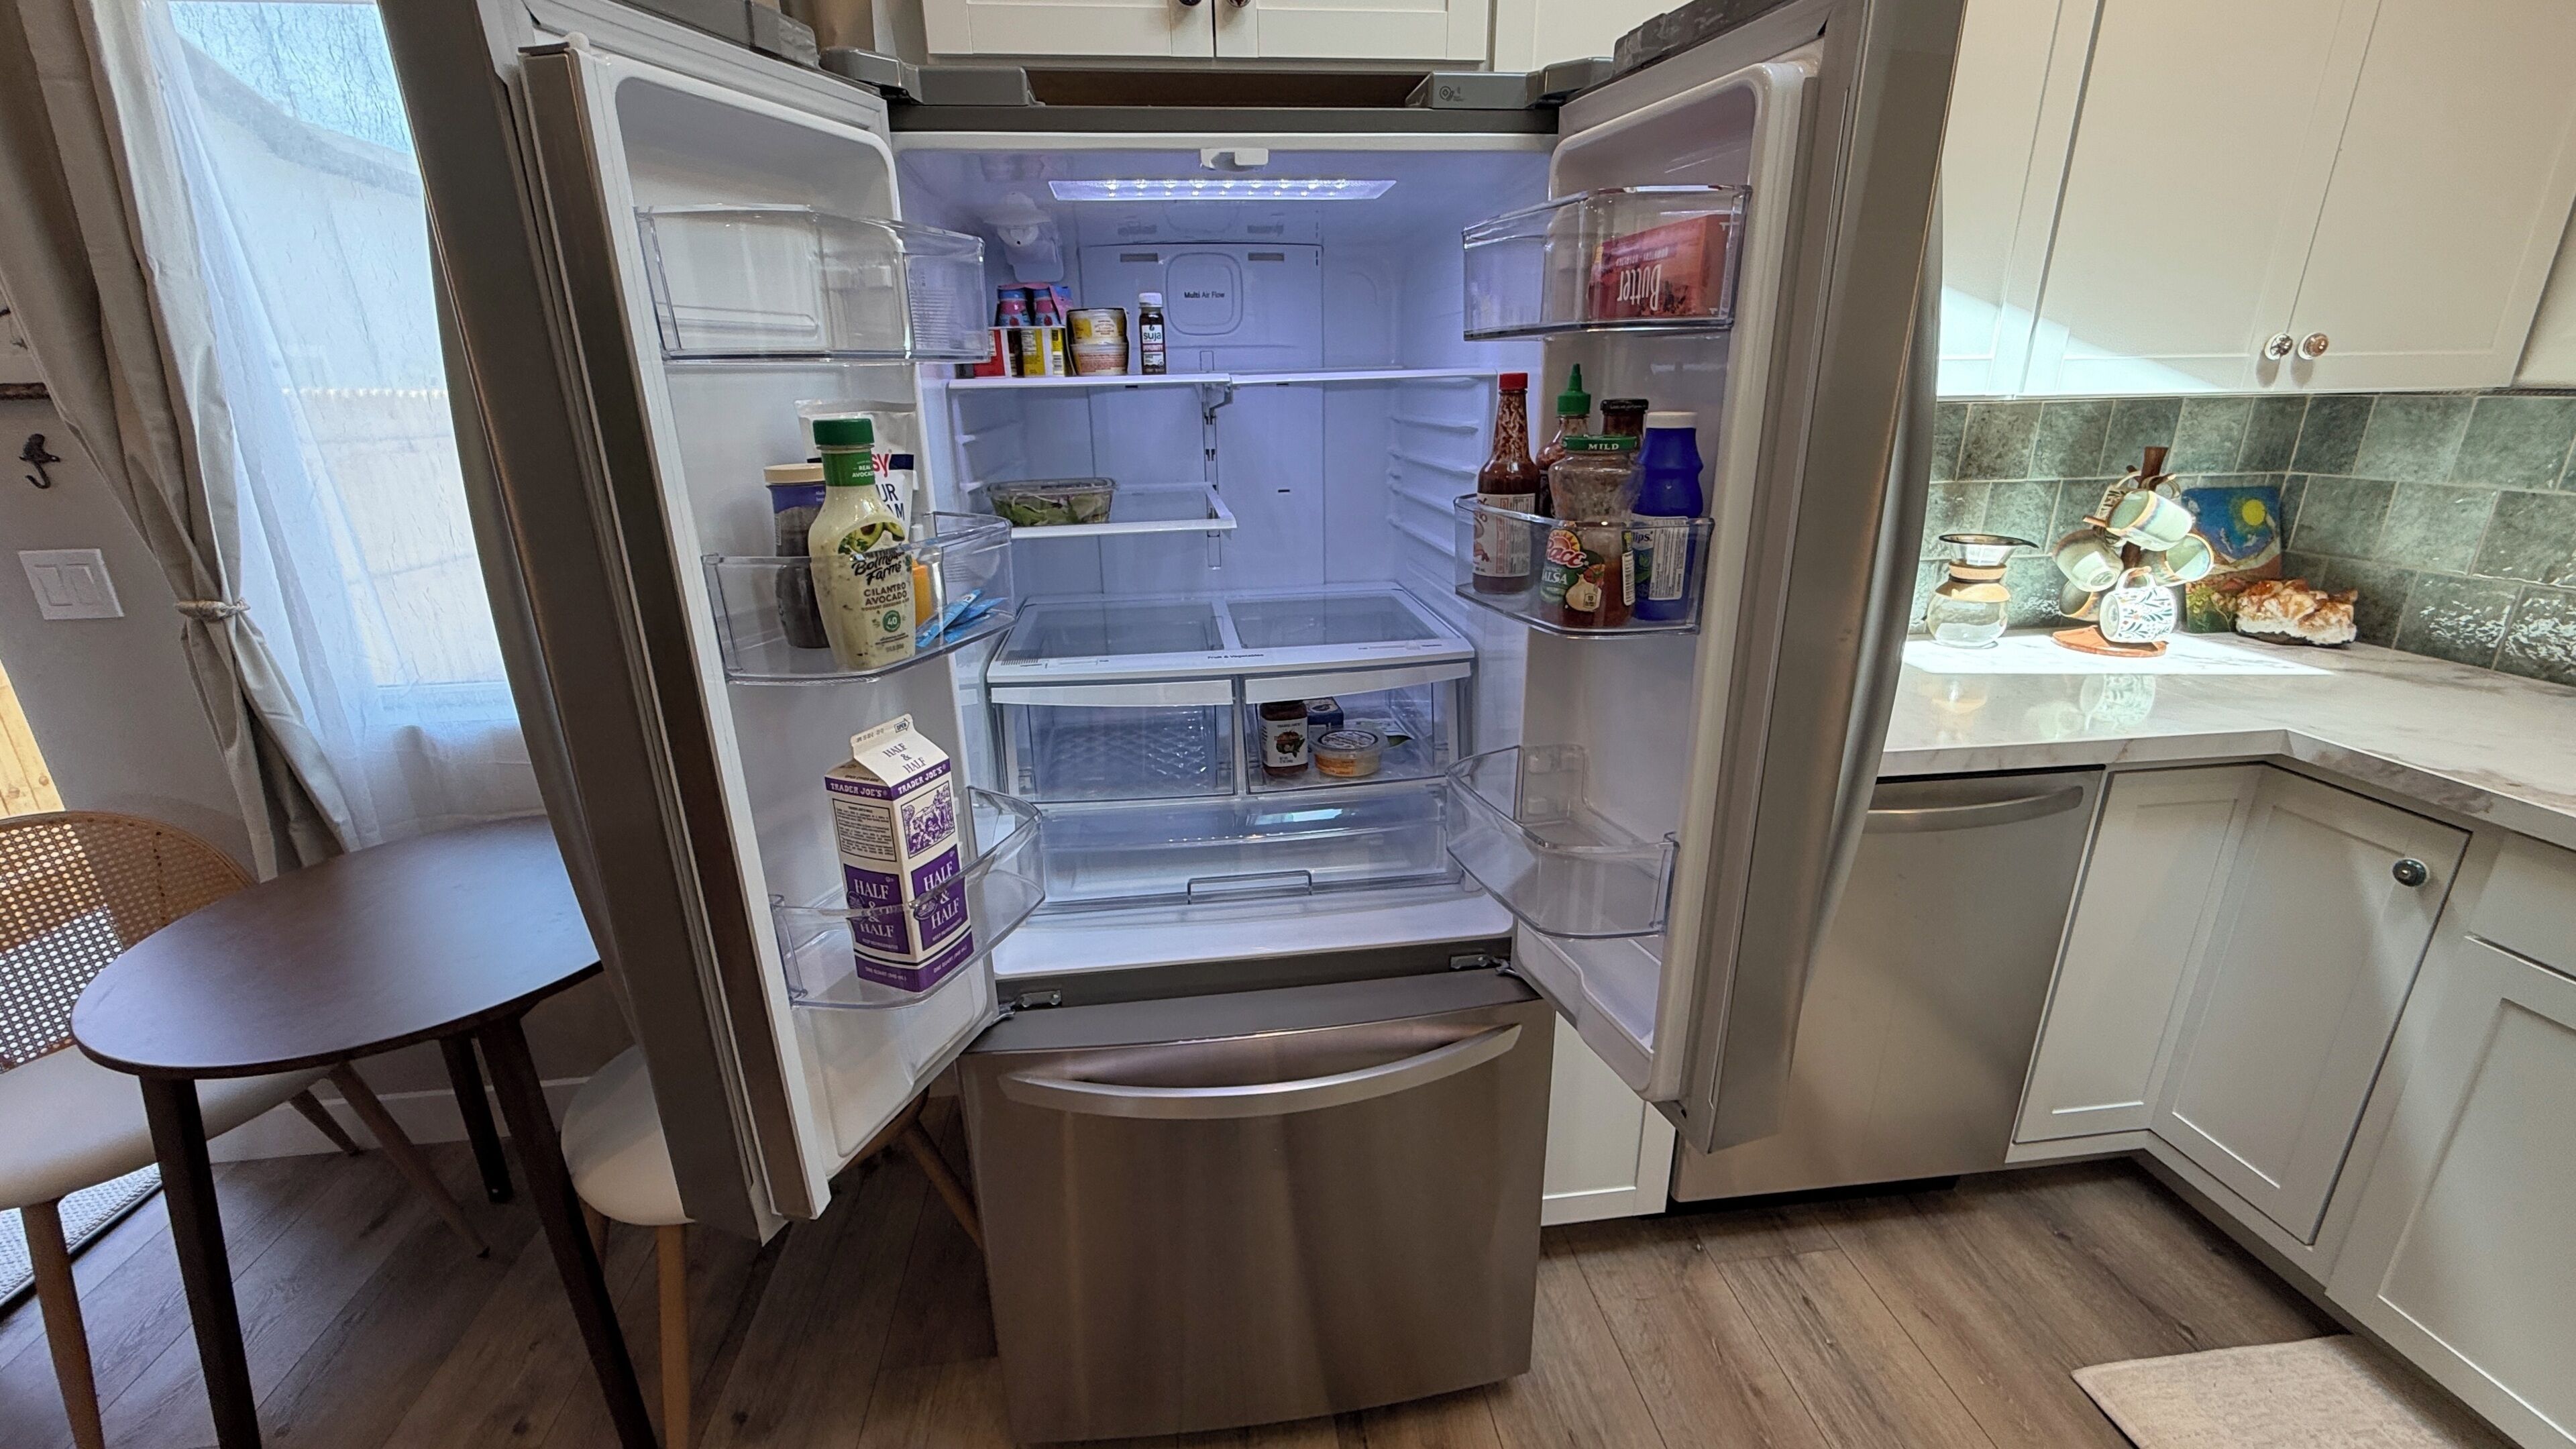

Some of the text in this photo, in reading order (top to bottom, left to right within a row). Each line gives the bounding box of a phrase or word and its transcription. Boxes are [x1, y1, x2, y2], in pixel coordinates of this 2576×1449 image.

[1617, 264, 1662, 311] Butter
[1143, 332, 1161, 341] suja
[875, 484, 898, 502] UR
[865, 561, 902, 586] Farms
[1542, 571, 1568, 586] ALSA
[863, 582, 906, 597] CILANTRO
[865, 590, 908, 606] AVOCADO
[887, 616, 898, 626] 40
[882, 743, 908, 757] HALF
[902, 757, 926, 773] HALF
[830, 782, 859, 794] TRADER
[898, 776, 924, 795] TRADER
[923, 861, 953, 892] HALF
[854, 879, 889, 900] HALF
[940, 889, 950, 904] &
[931, 897, 959, 930] HALF
[860, 924, 894, 938] HALF
